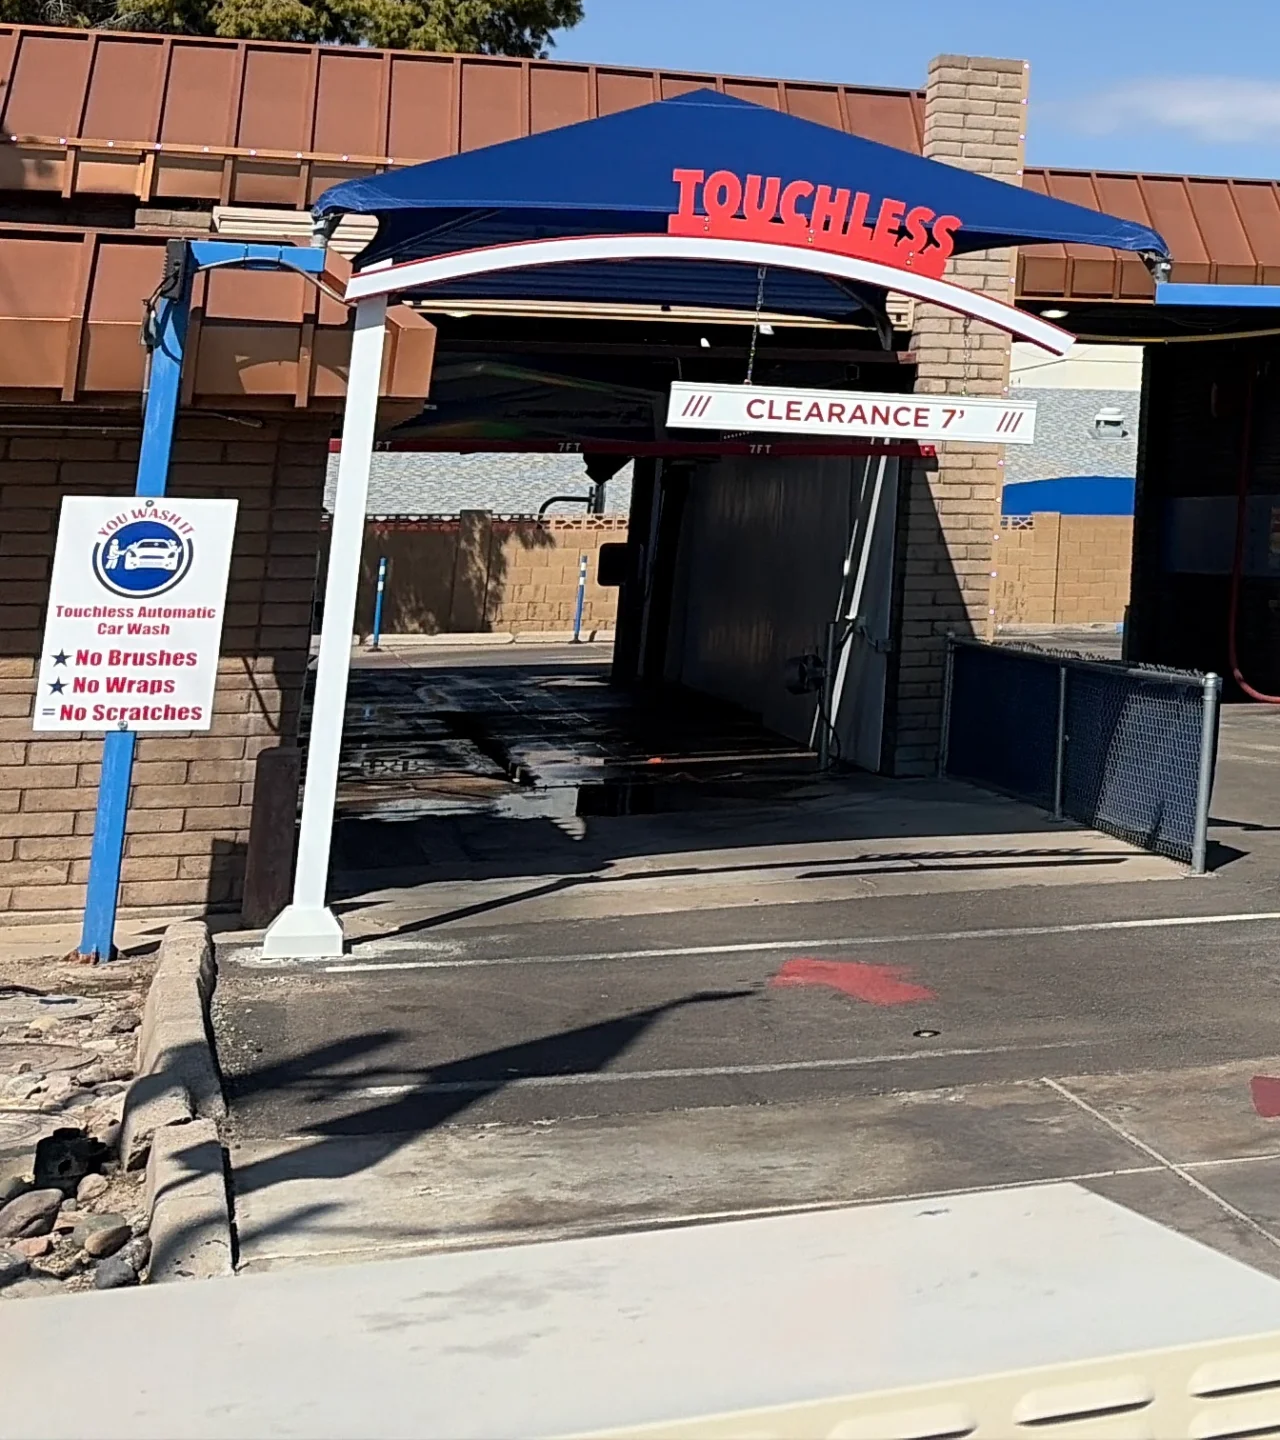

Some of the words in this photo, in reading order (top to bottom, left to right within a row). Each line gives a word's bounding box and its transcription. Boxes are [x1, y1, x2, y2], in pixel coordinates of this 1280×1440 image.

[670, 168, 963, 262] TOUCHLESS
[746, 399, 930, 428] CLEARANCE
[942, 409, 965, 428] 7'
[97, 513, 128, 537] YOU
[131, 508, 181, 526] WASH
[178, 522, 195, 535] IT
[56, 605, 134, 618] Touchless
[137, 606, 216, 619] Automatic
[97, 622, 124, 635] Car
[127, 622, 170, 635] Wash
[75, 649, 103, 666] No
[108, 649, 198, 666] Brushes
[72, 676, 100, 693] No
[106, 676, 176, 695] Wraps
[59, 704, 87, 721] No
[92, 704, 203, 721] Scratches
